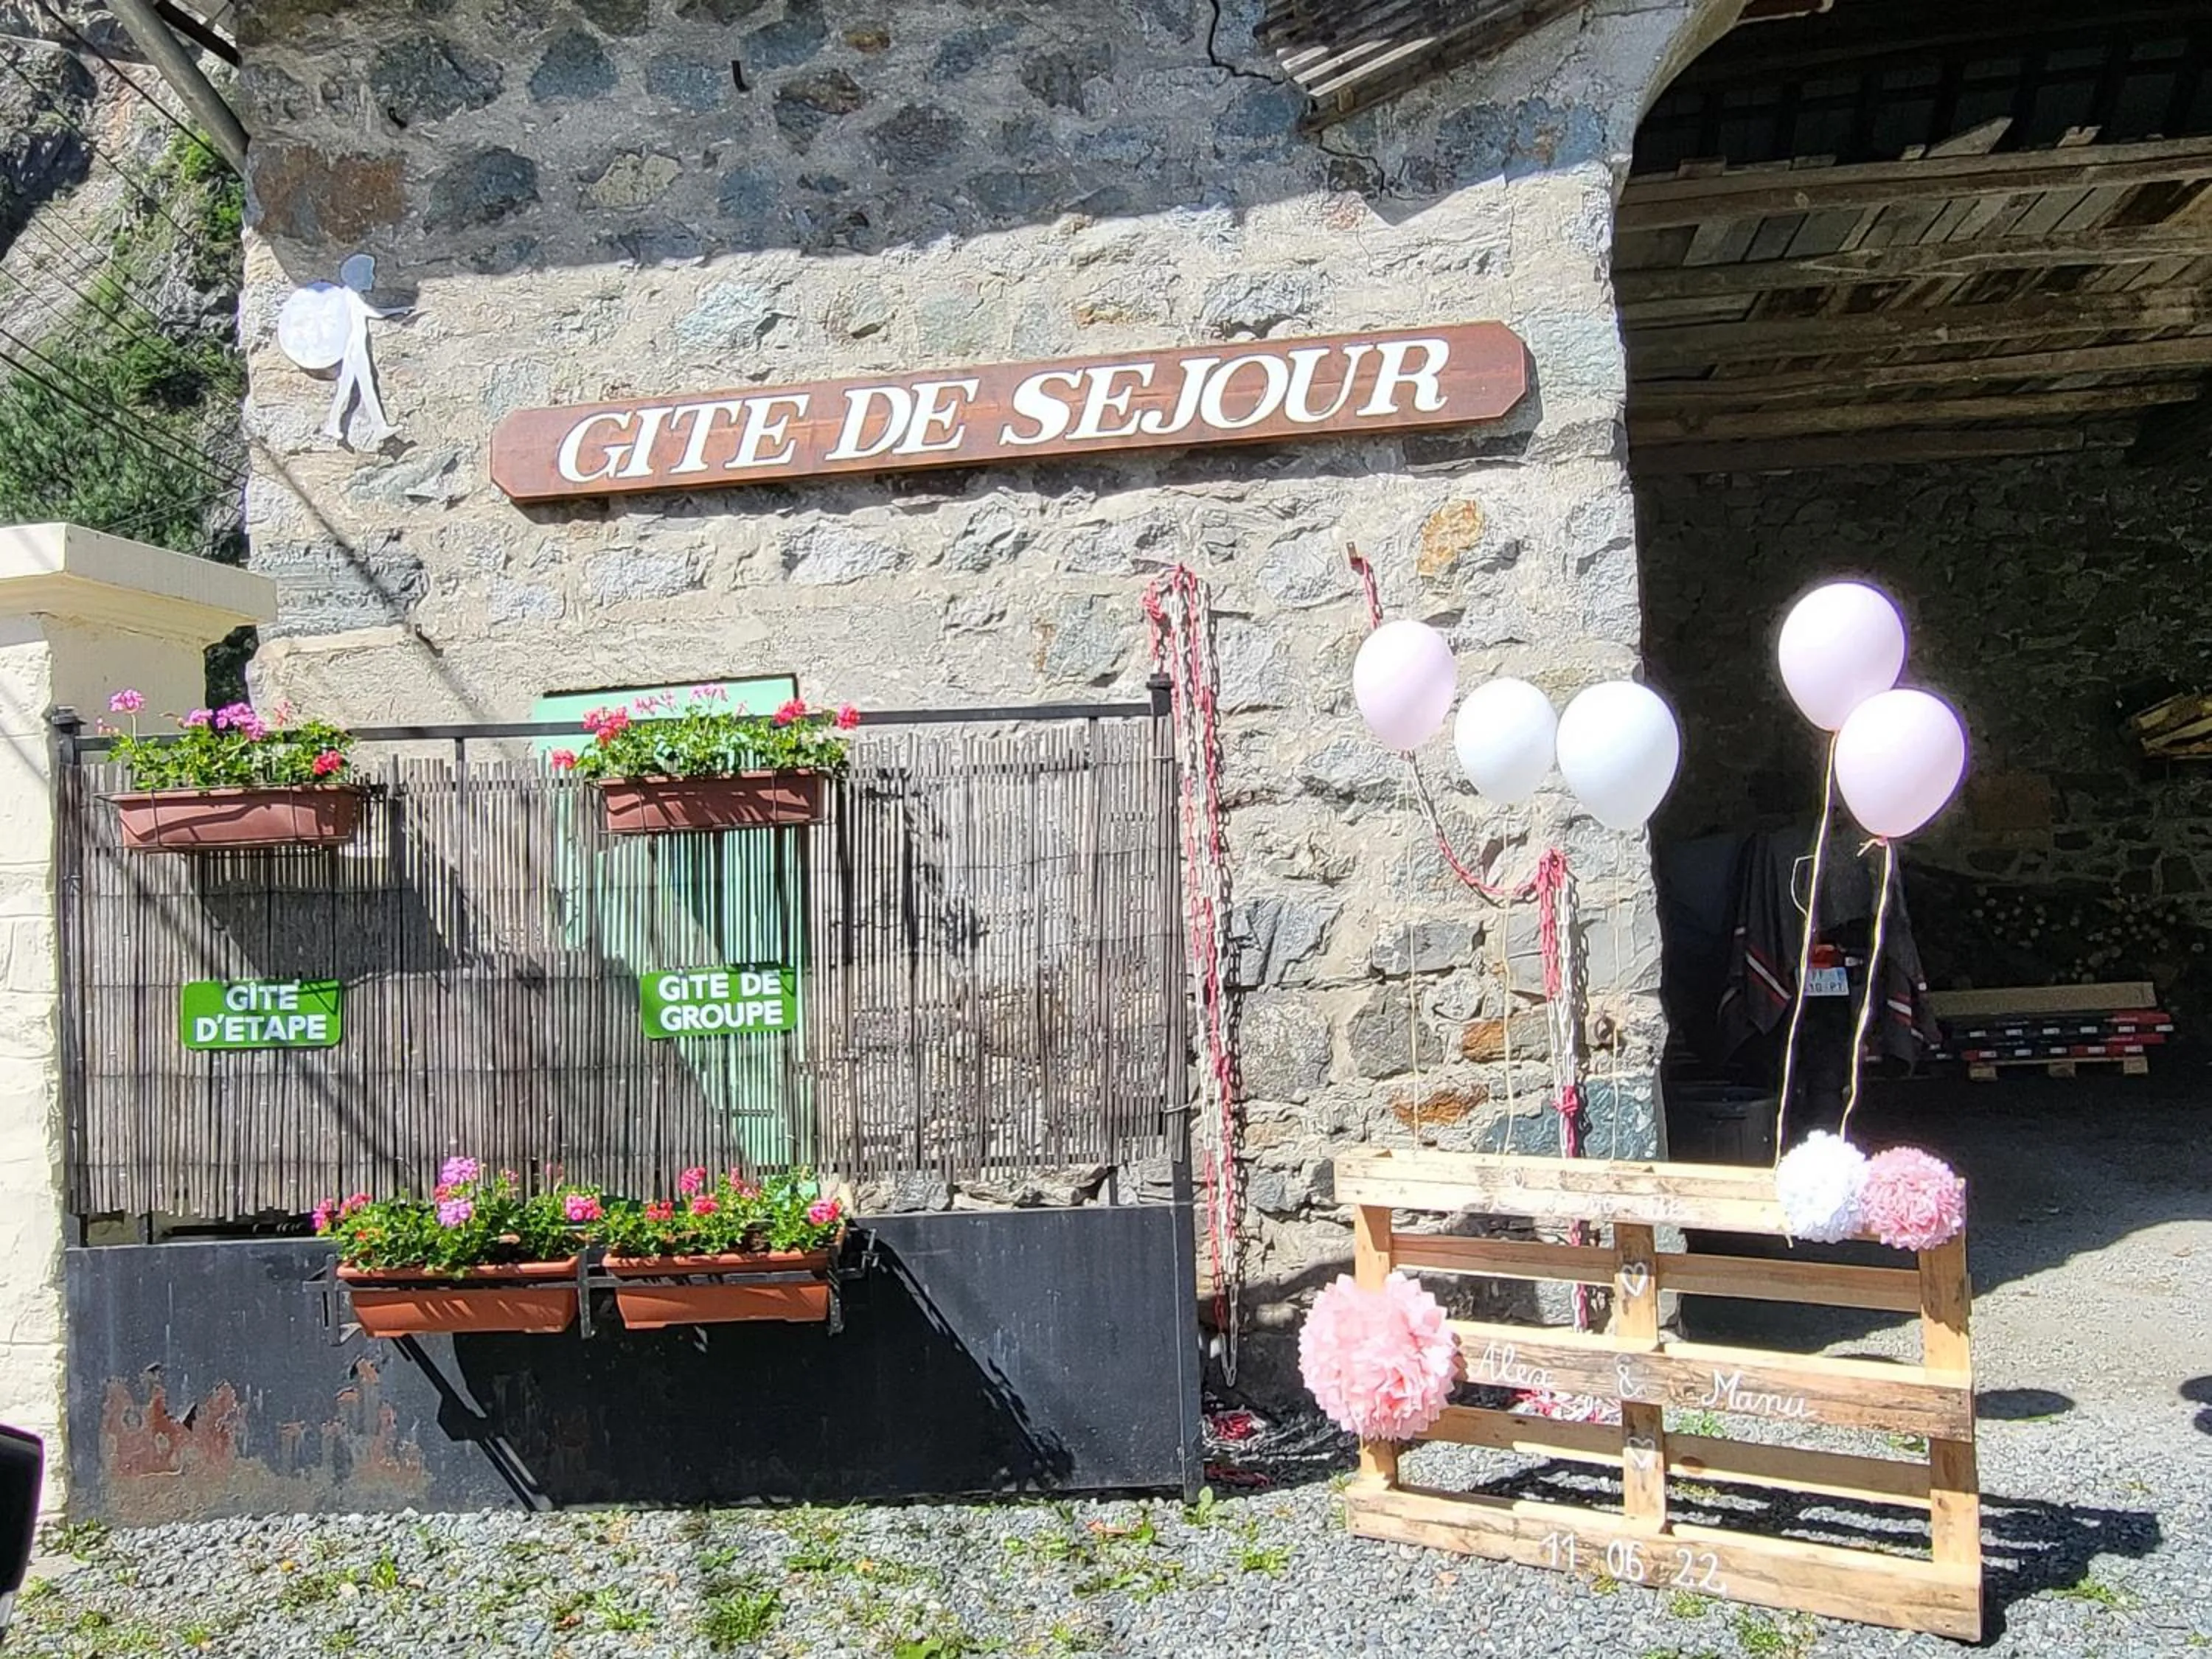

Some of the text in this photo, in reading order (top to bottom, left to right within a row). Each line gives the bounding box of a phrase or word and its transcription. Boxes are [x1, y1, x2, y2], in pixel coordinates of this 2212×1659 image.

[558, 337, 1450, 483] GITE DE SEJOUR
[741, 970, 782, 996] DE
[195, 1013, 327, 1043] D'ETAPE
[660, 999, 784, 1032] GROUPE
[1615, 1363, 1643, 1399] &
[1701, 1368, 1818, 1418] Manu
[1539, 1531, 1728, 1597] 11 06 22
